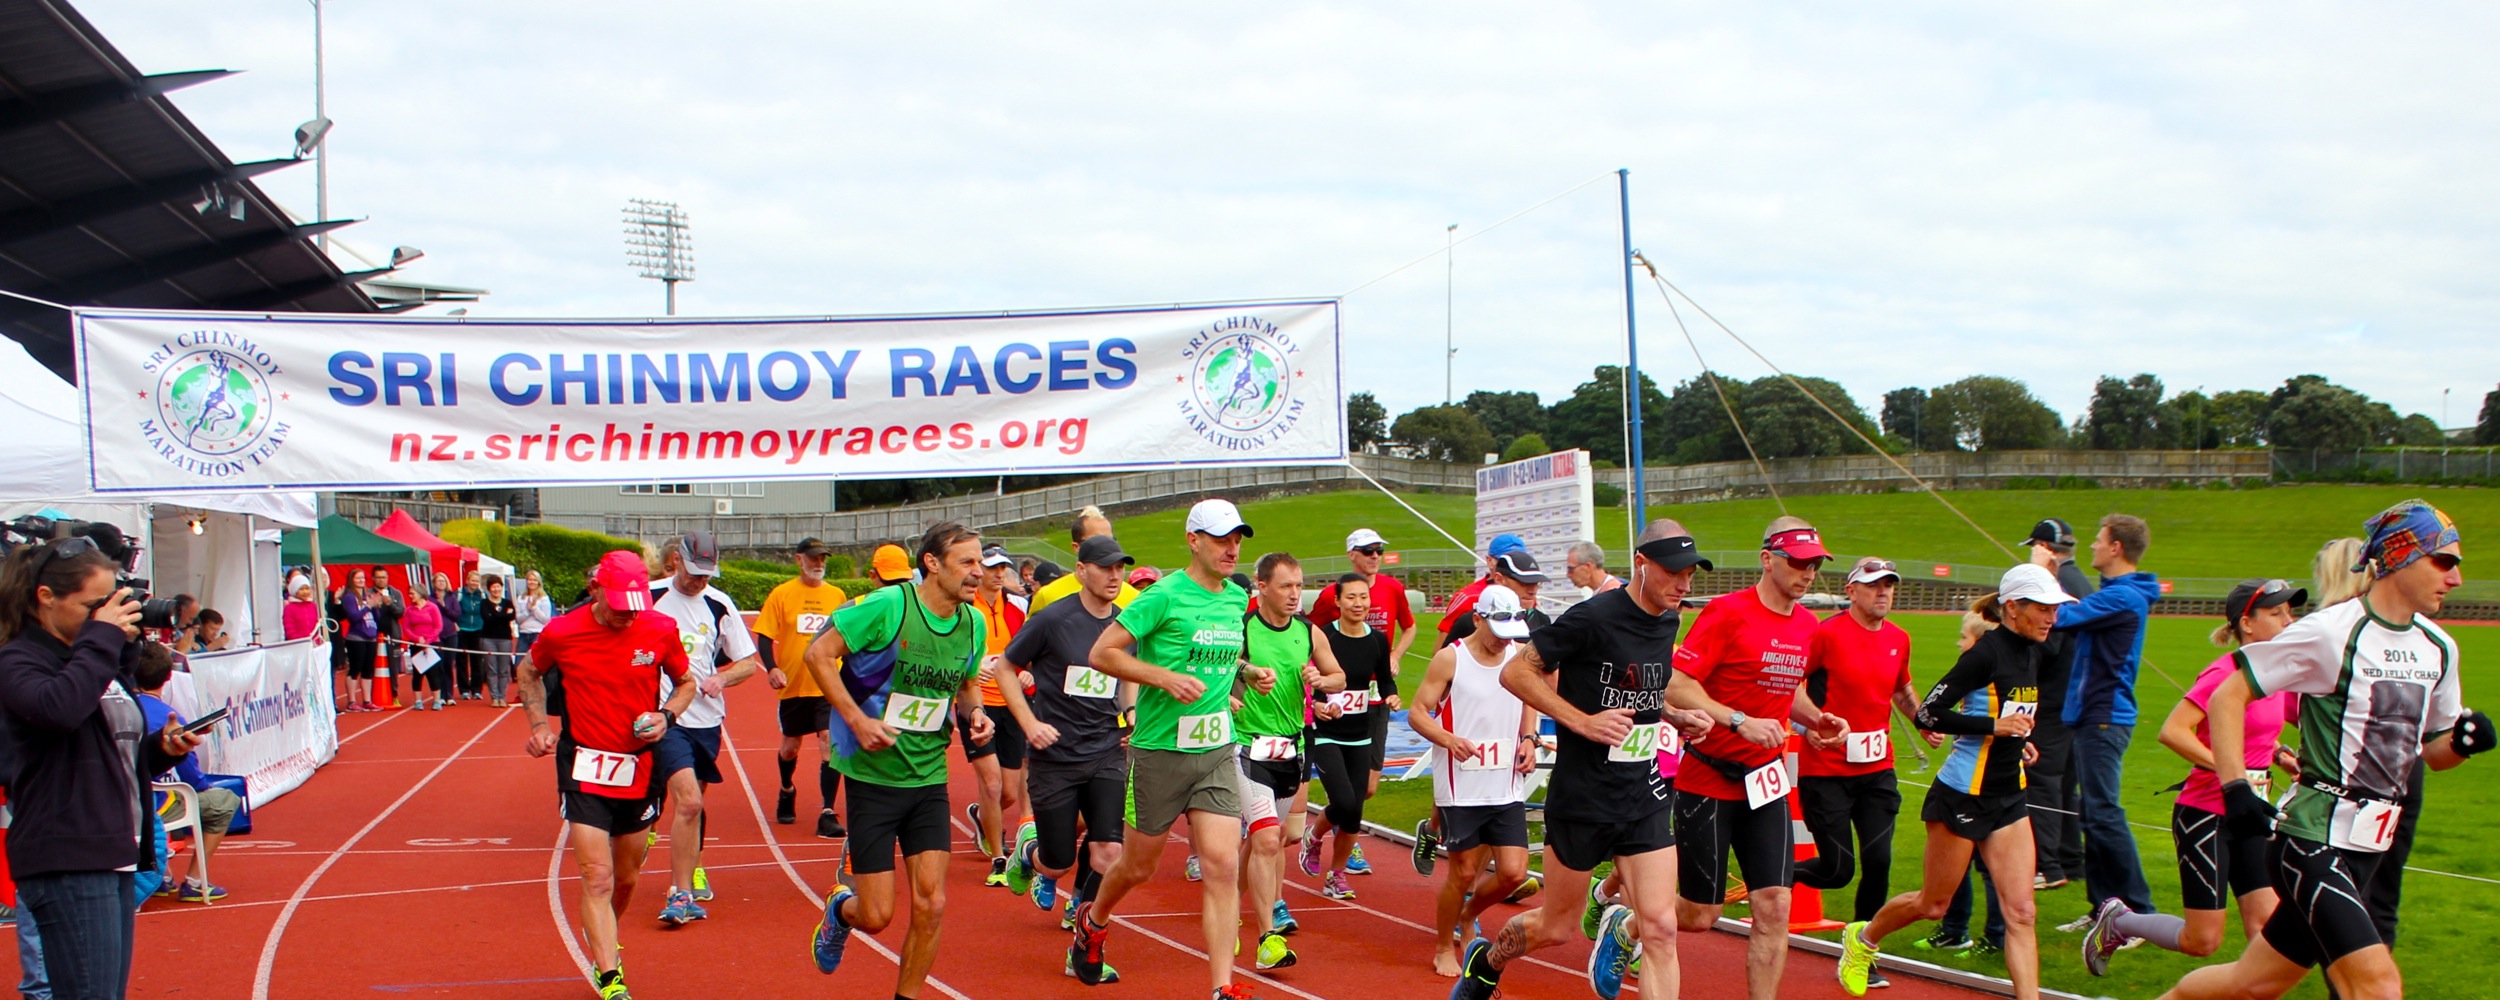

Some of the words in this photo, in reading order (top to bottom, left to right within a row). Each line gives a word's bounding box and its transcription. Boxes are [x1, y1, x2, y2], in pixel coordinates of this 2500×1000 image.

[1182, 330, 1209, 360] SRI
[1213, 316, 1300, 355] CHINMOY
[143, 343, 175, 374] SRI
[177, 330, 283, 377] CHINMOY
[327, 350, 458, 407] SRI
[489, 349, 861, 406] CHINMOY
[889, 337, 1138, 398] RACES
[1177, 399, 1265, 451] MARATHON
[1267, 398, 1306, 441] TEAM
[139, 418, 245, 477] MARATHON
[247, 421, 292, 466] TEAM
[389, 417, 1090, 465] nz.srichinmoyraces.org
[804, 615, 825, 631] 22
[1192, 630, 1213, 645] 49
[1761, 651, 1785, 664] HIGH
[2384, 649, 2417, 663] 2014
[903, 675, 956, 693] RAMBLERS
[1075, 670, 1108, 695] 43
[1600, 662, 1613, 684] I
[1619, 663, 1663, 689] AM
[2363, 668, 2382, 678] NED
[2384, 669, 2412, 679] KELLY
[226, 695, 242, 740] Sri
[242, 690, 284, 734] Chinmoy
[283, 682, 305, 721] Races
[898, 699, 939, 728] 47
[1342, 692, 1364, 711] 24
[1189, 716, 1222, 744] 48
[1622, 727, 1655, 757] 42
[1477, 742, 1498, 766] 11
[1861, 733, 1882, 758] 13
[591, 753, 625, 782] 17
[1755, 766, 1782, 800] 19
[2314, 780, 2349, 797] 2XU
